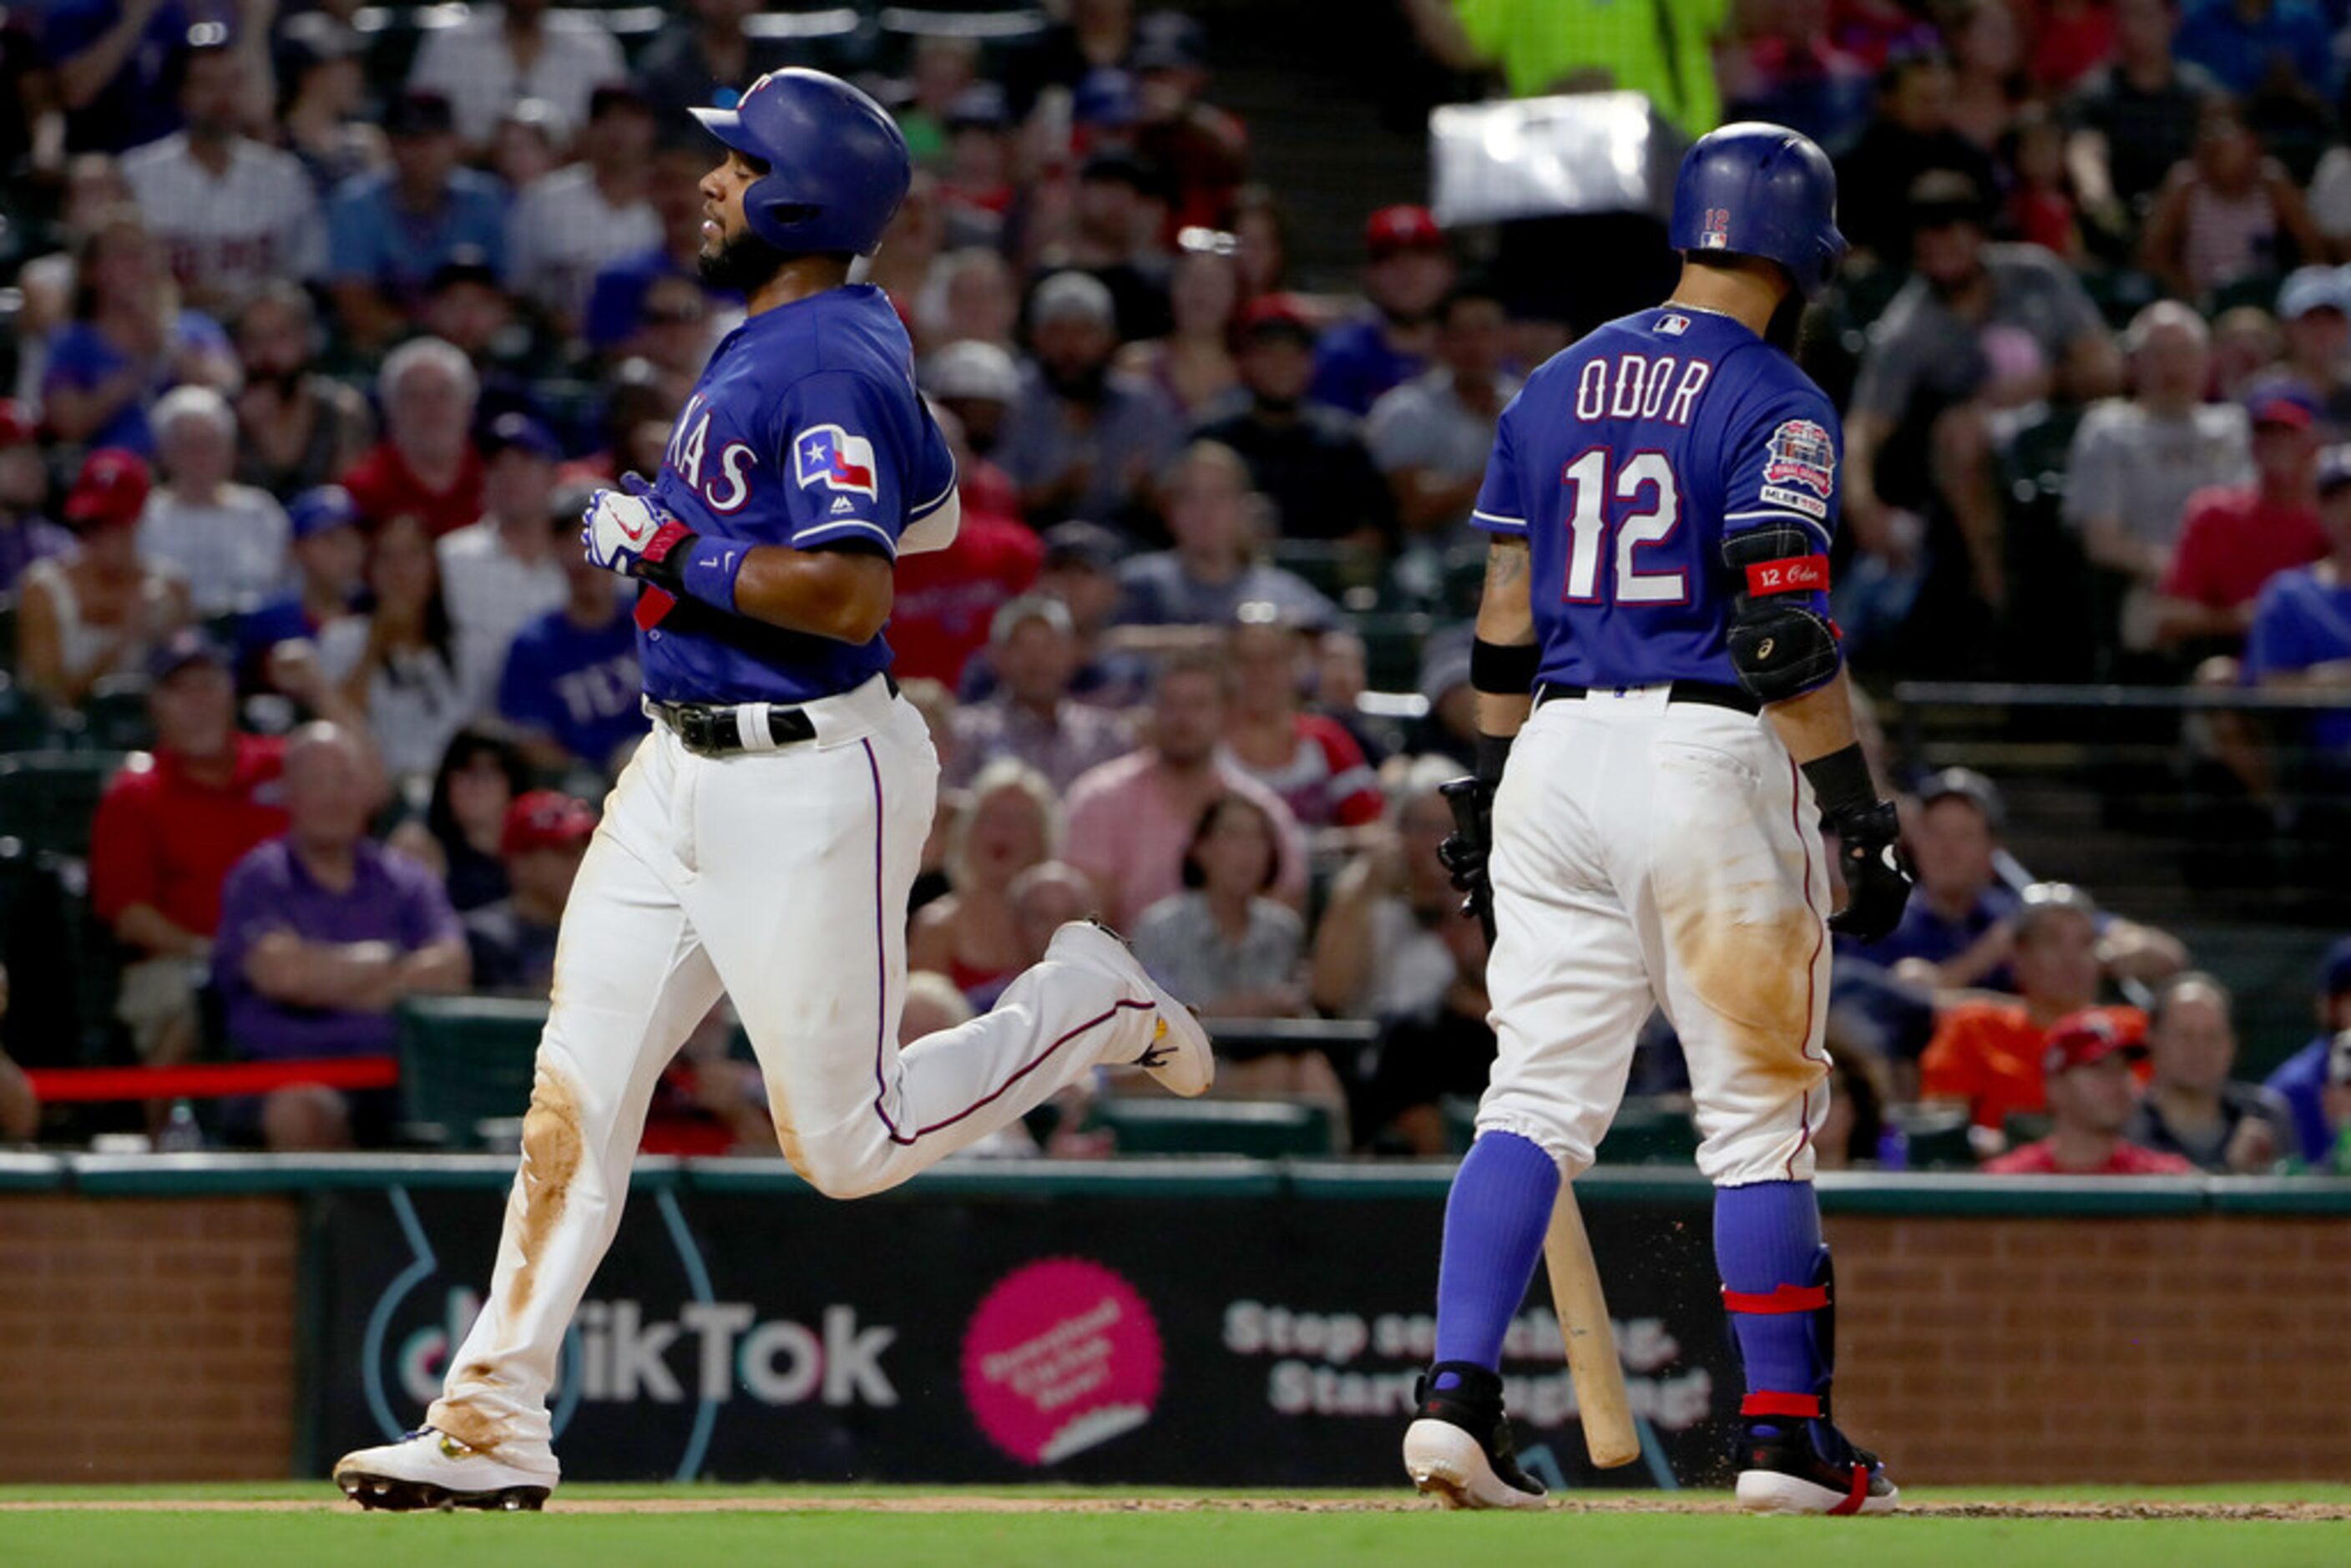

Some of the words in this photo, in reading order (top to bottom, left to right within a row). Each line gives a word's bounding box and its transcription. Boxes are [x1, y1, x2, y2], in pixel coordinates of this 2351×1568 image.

[1705, 208, 1729, 231] 12
[1575, 353, 1711, 426] ODOR
[1561, 445, 1690, 606] 12
[1761, 569, 1781, 587] 12
[553, 1300, 899, 1407] ikTok
[1222, 1300, 1368, 1364] Stop
